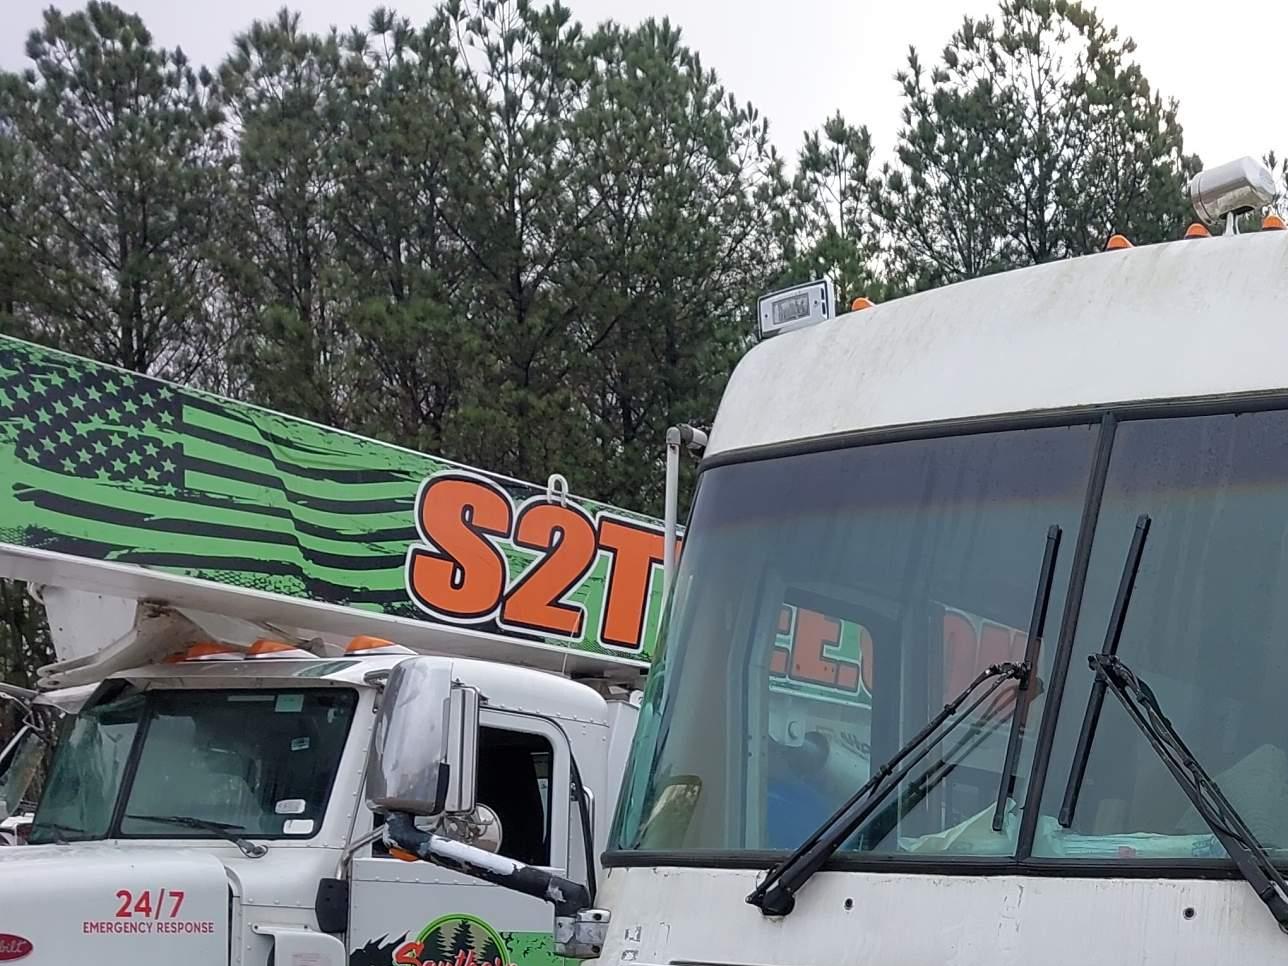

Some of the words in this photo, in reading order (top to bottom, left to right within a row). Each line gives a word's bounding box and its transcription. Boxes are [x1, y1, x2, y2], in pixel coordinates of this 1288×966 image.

[115, 888, 185, 920] 24/7
[82, 921, 153, 934] EMERGENCY
[156, 921, 214, 934] RESPONSE
